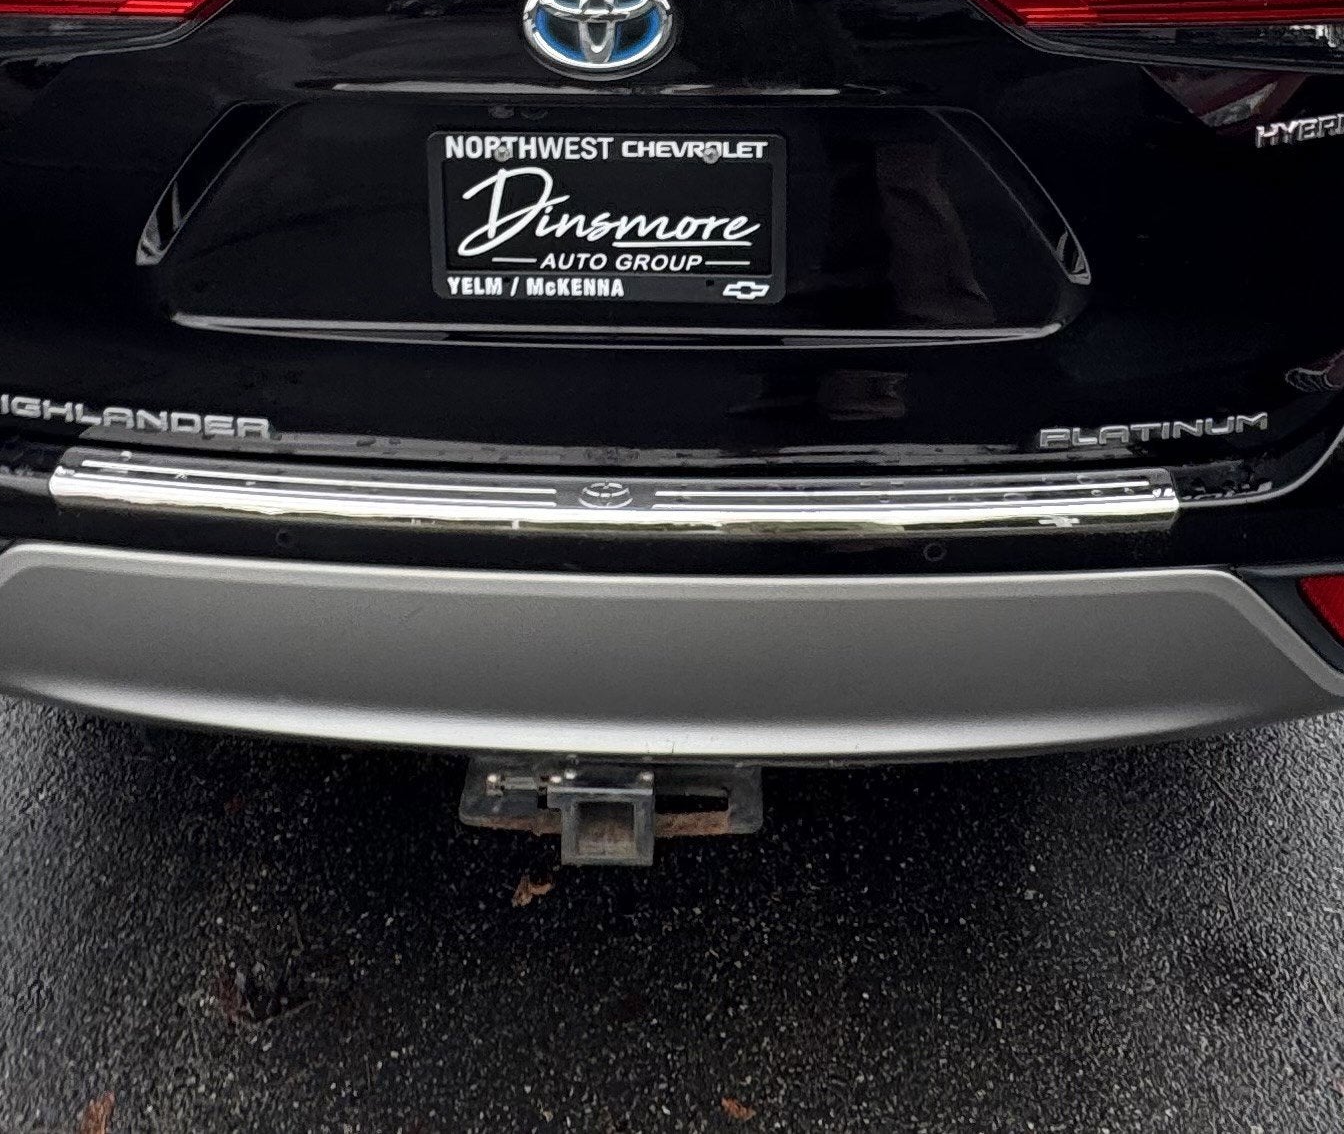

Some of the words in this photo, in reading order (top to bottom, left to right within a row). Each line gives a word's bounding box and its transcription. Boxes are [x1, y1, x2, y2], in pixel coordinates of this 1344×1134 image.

[445, 135, 614, 160] NORTHWEST
[621, 141, 768, 159] CHEVROLET
[457, 166, 761, 257] Dinsmore
[540, 253, 607, 271] AUTO
[615, 254, 703, 272] GROUP
[447, 277, 502, 296] YELM
[526, 277, 625, 297] McKENNA
[1038, 412, 1268, 448] PLATINUM
